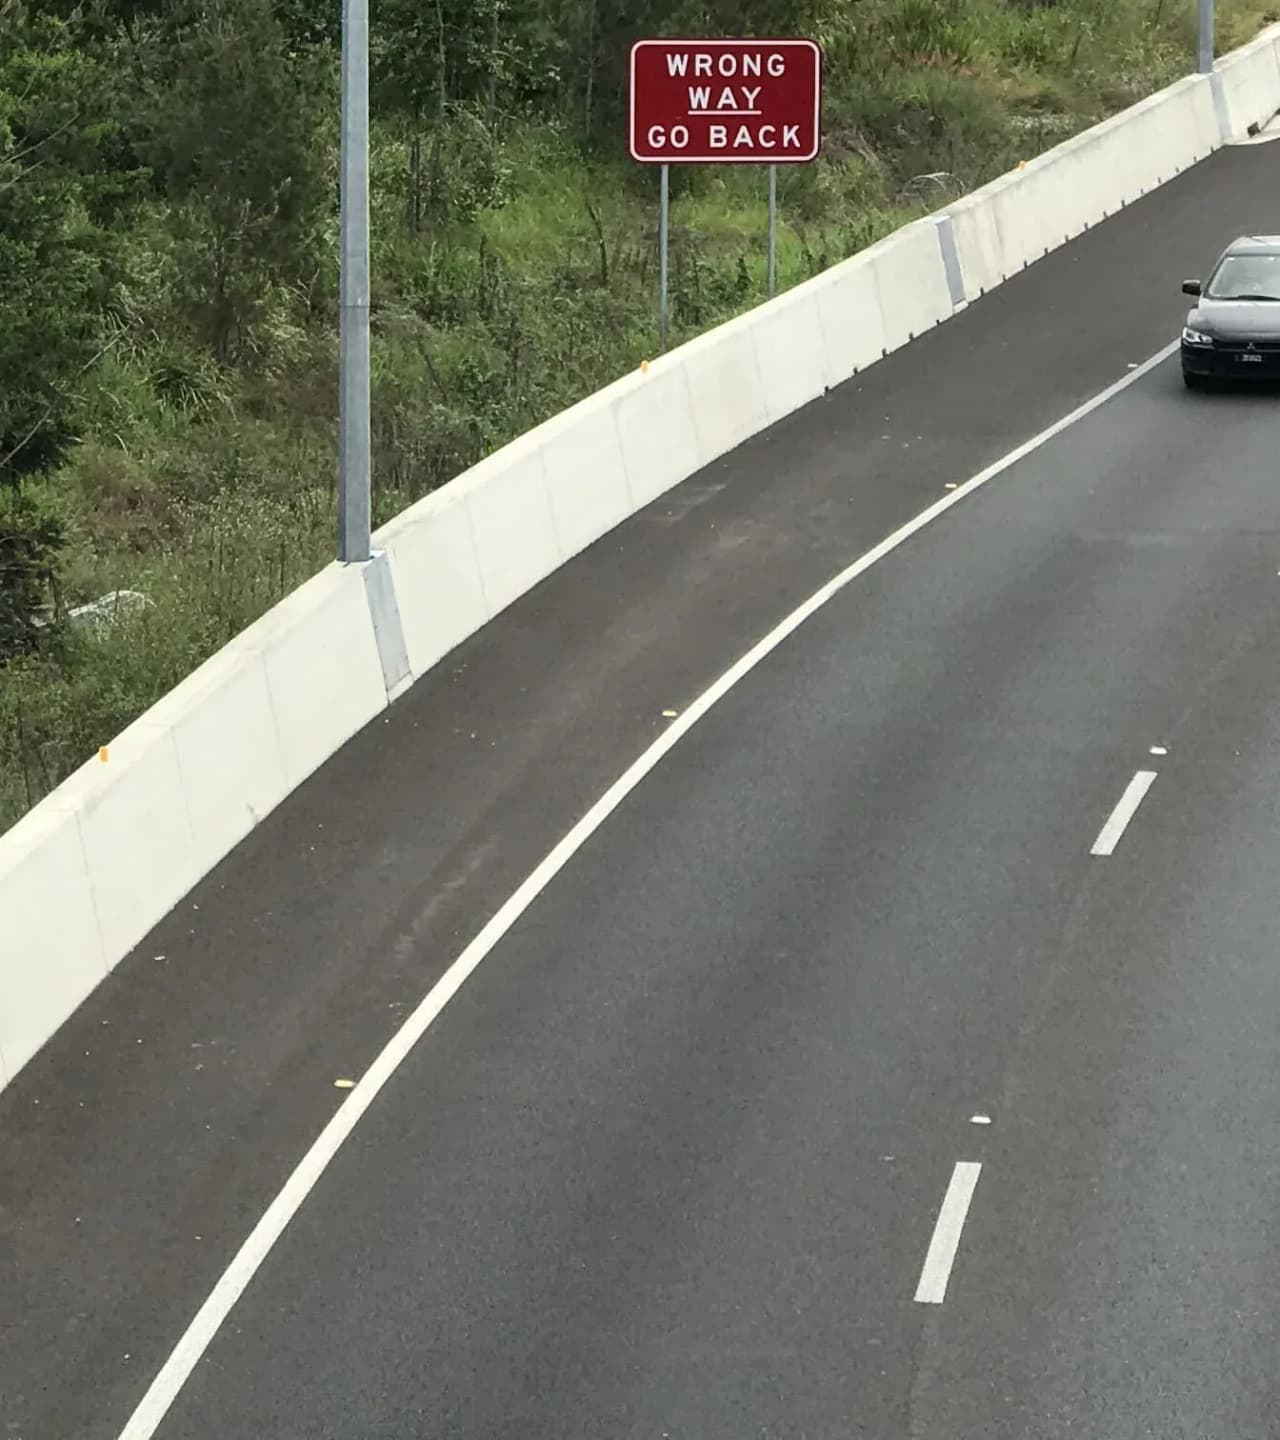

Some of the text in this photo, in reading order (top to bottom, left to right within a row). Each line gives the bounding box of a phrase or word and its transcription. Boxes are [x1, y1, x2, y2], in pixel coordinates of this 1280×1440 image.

[666, 53, 786, 77] WRONG
[688, 86, 762, 110] WAY
[647, 125, 801, 149] GO BACK
